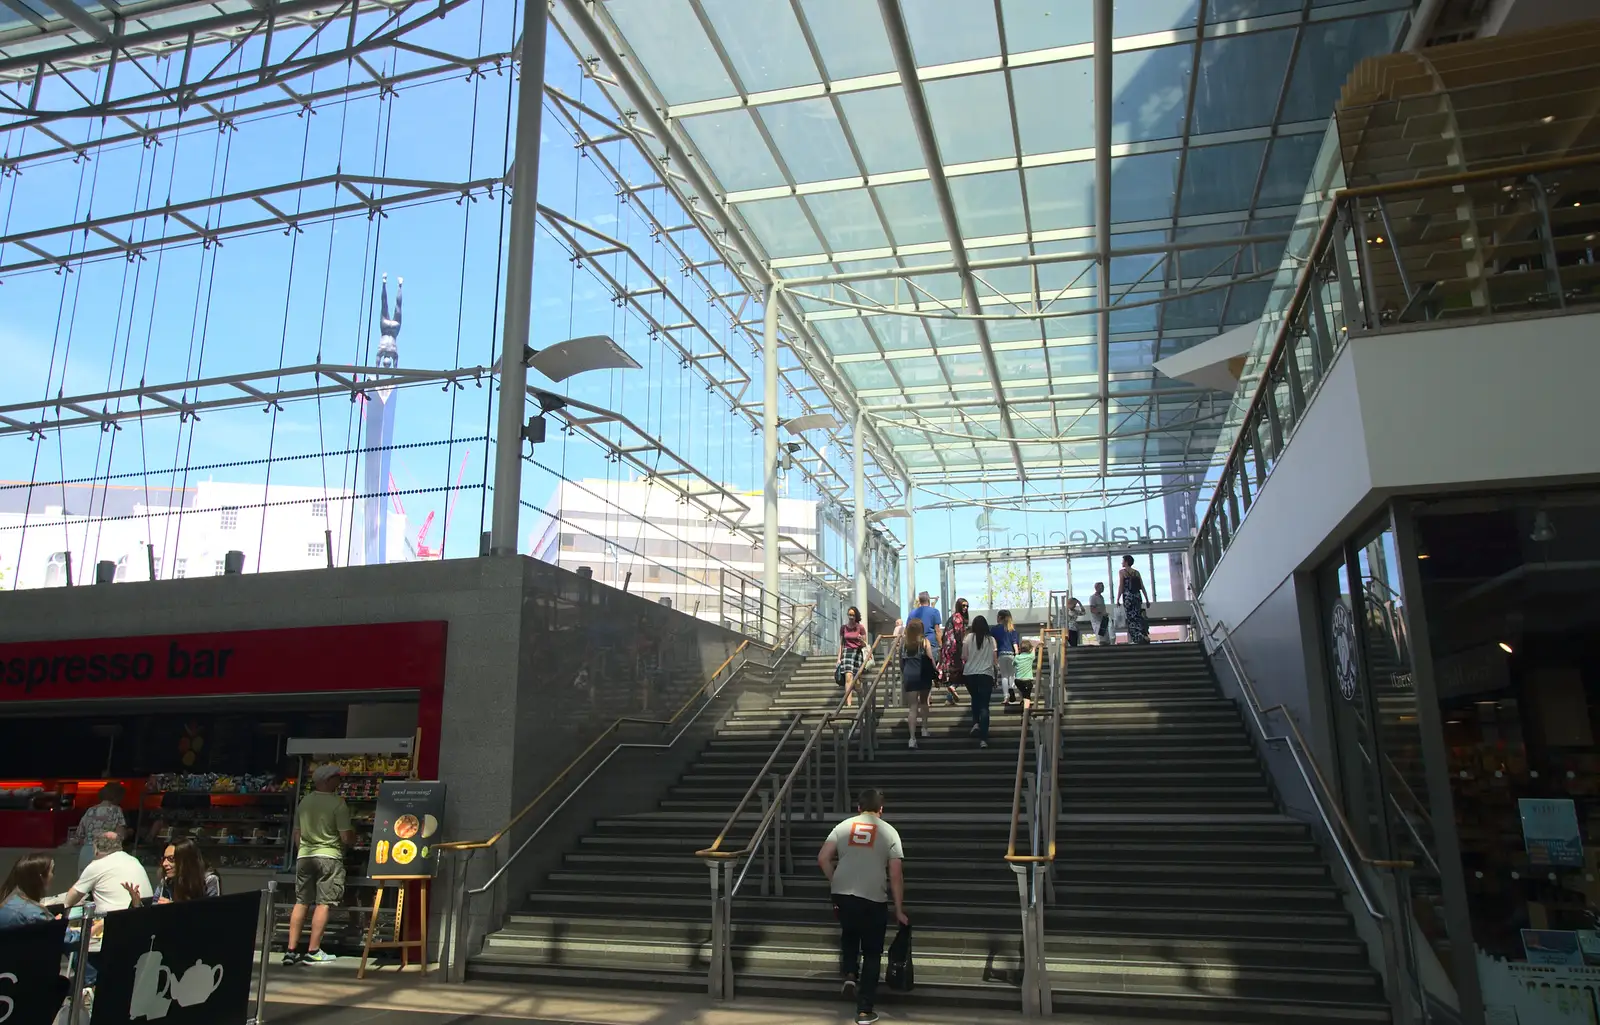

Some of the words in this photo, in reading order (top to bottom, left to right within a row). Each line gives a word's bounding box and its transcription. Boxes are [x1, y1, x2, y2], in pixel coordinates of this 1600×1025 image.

[0, 651, 153, 693] spresso
[168, 641, 235, 678] bar
[391, 788, 406, 796] good
